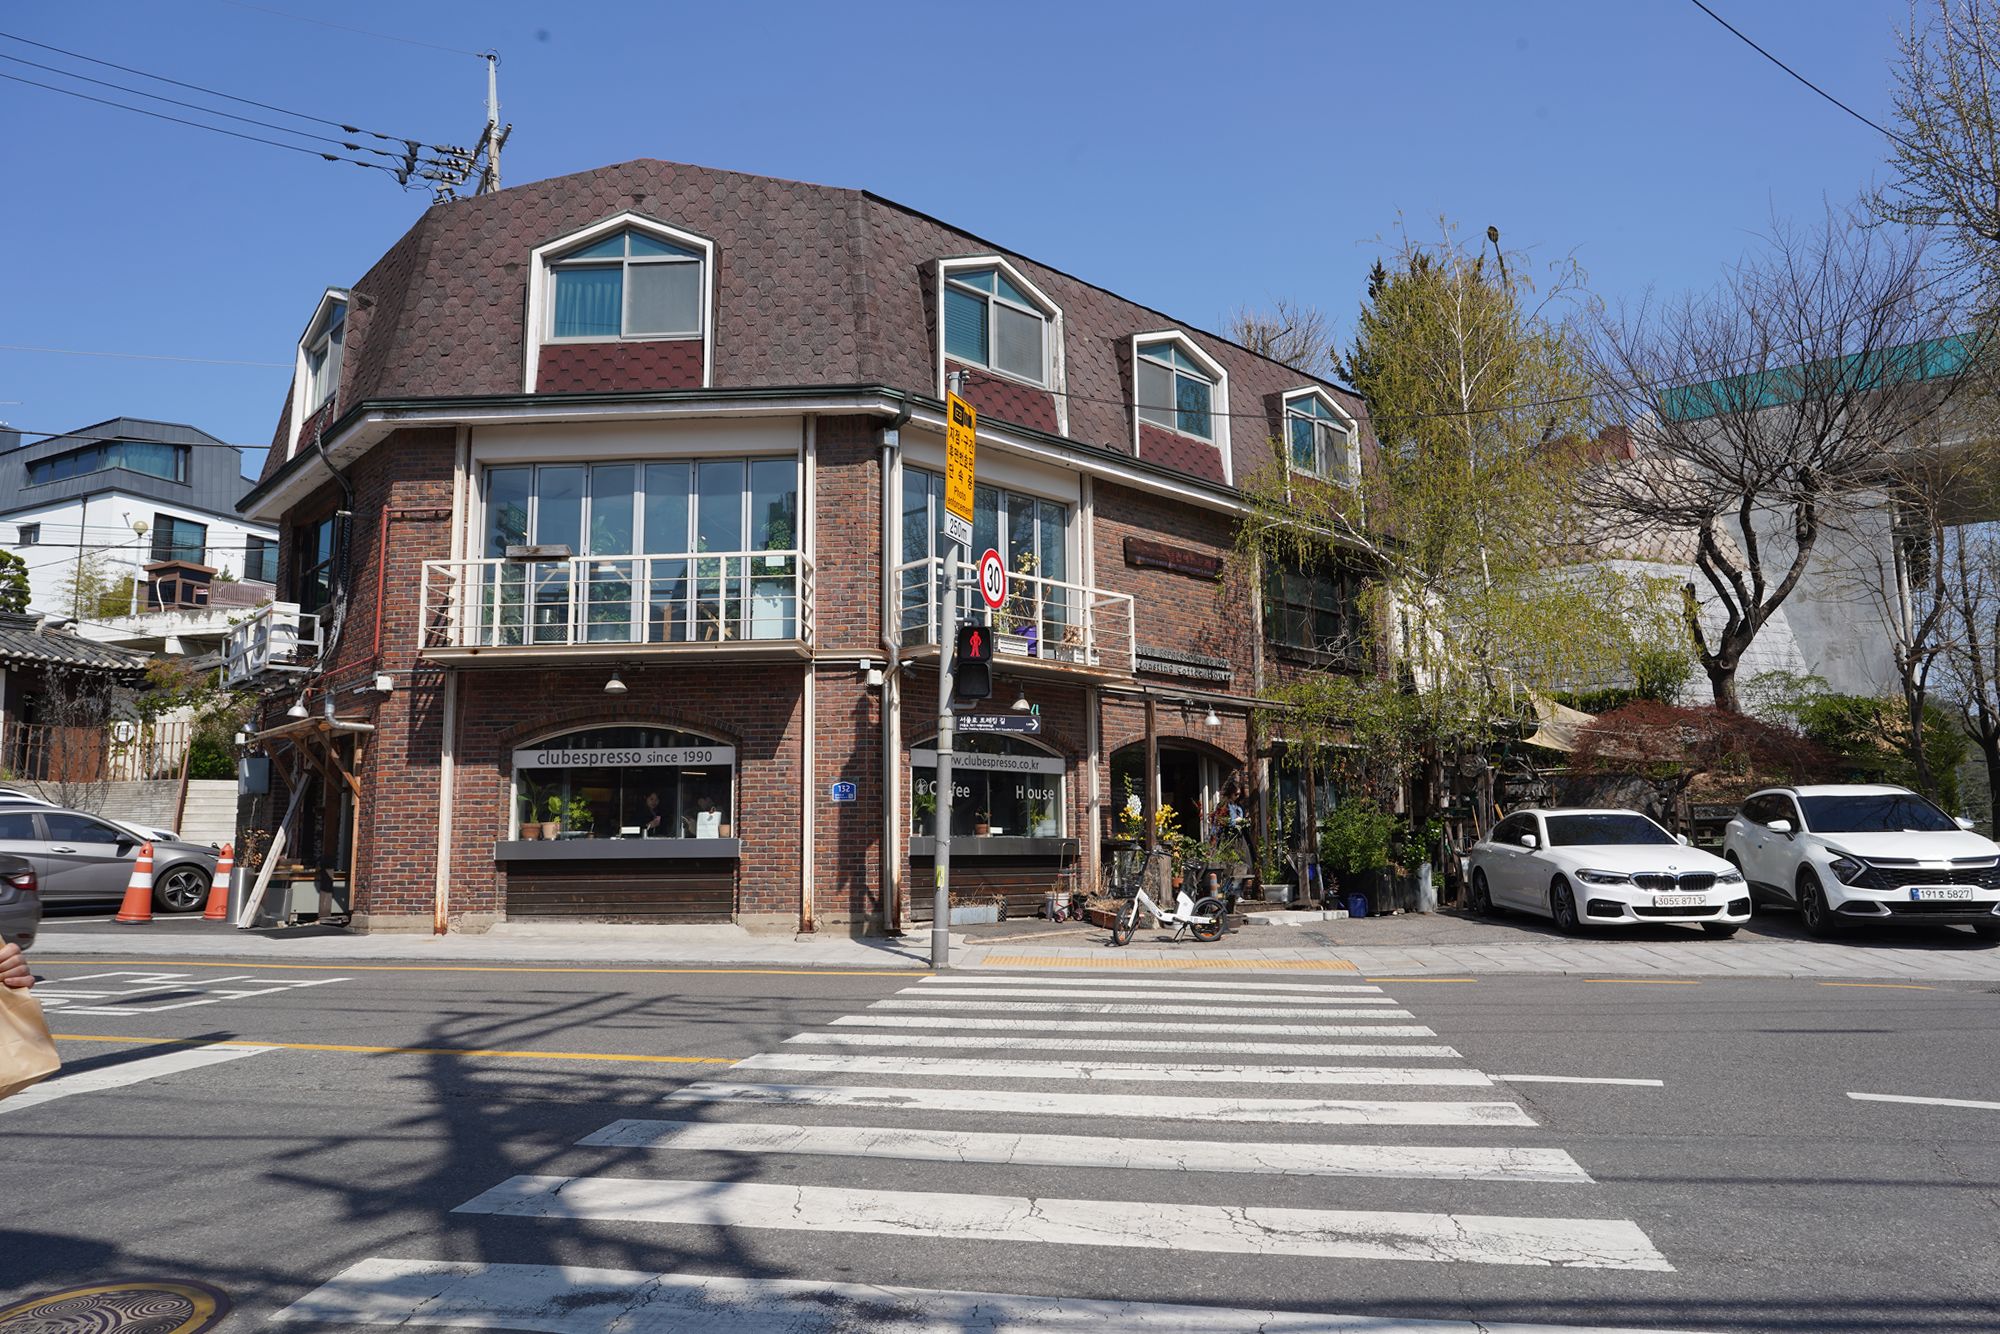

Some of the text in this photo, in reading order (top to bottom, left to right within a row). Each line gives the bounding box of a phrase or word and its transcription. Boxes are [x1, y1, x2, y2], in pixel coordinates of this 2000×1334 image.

[950, 518, 968, 541] 250m
[987, 563, 1000, 594] 30
[537, 750, 712, 766] clubespresso since 1990
[951, 755, 1040, 771] w.clubespresso.co.kr
[929, 780, 971, 798] Cfee
